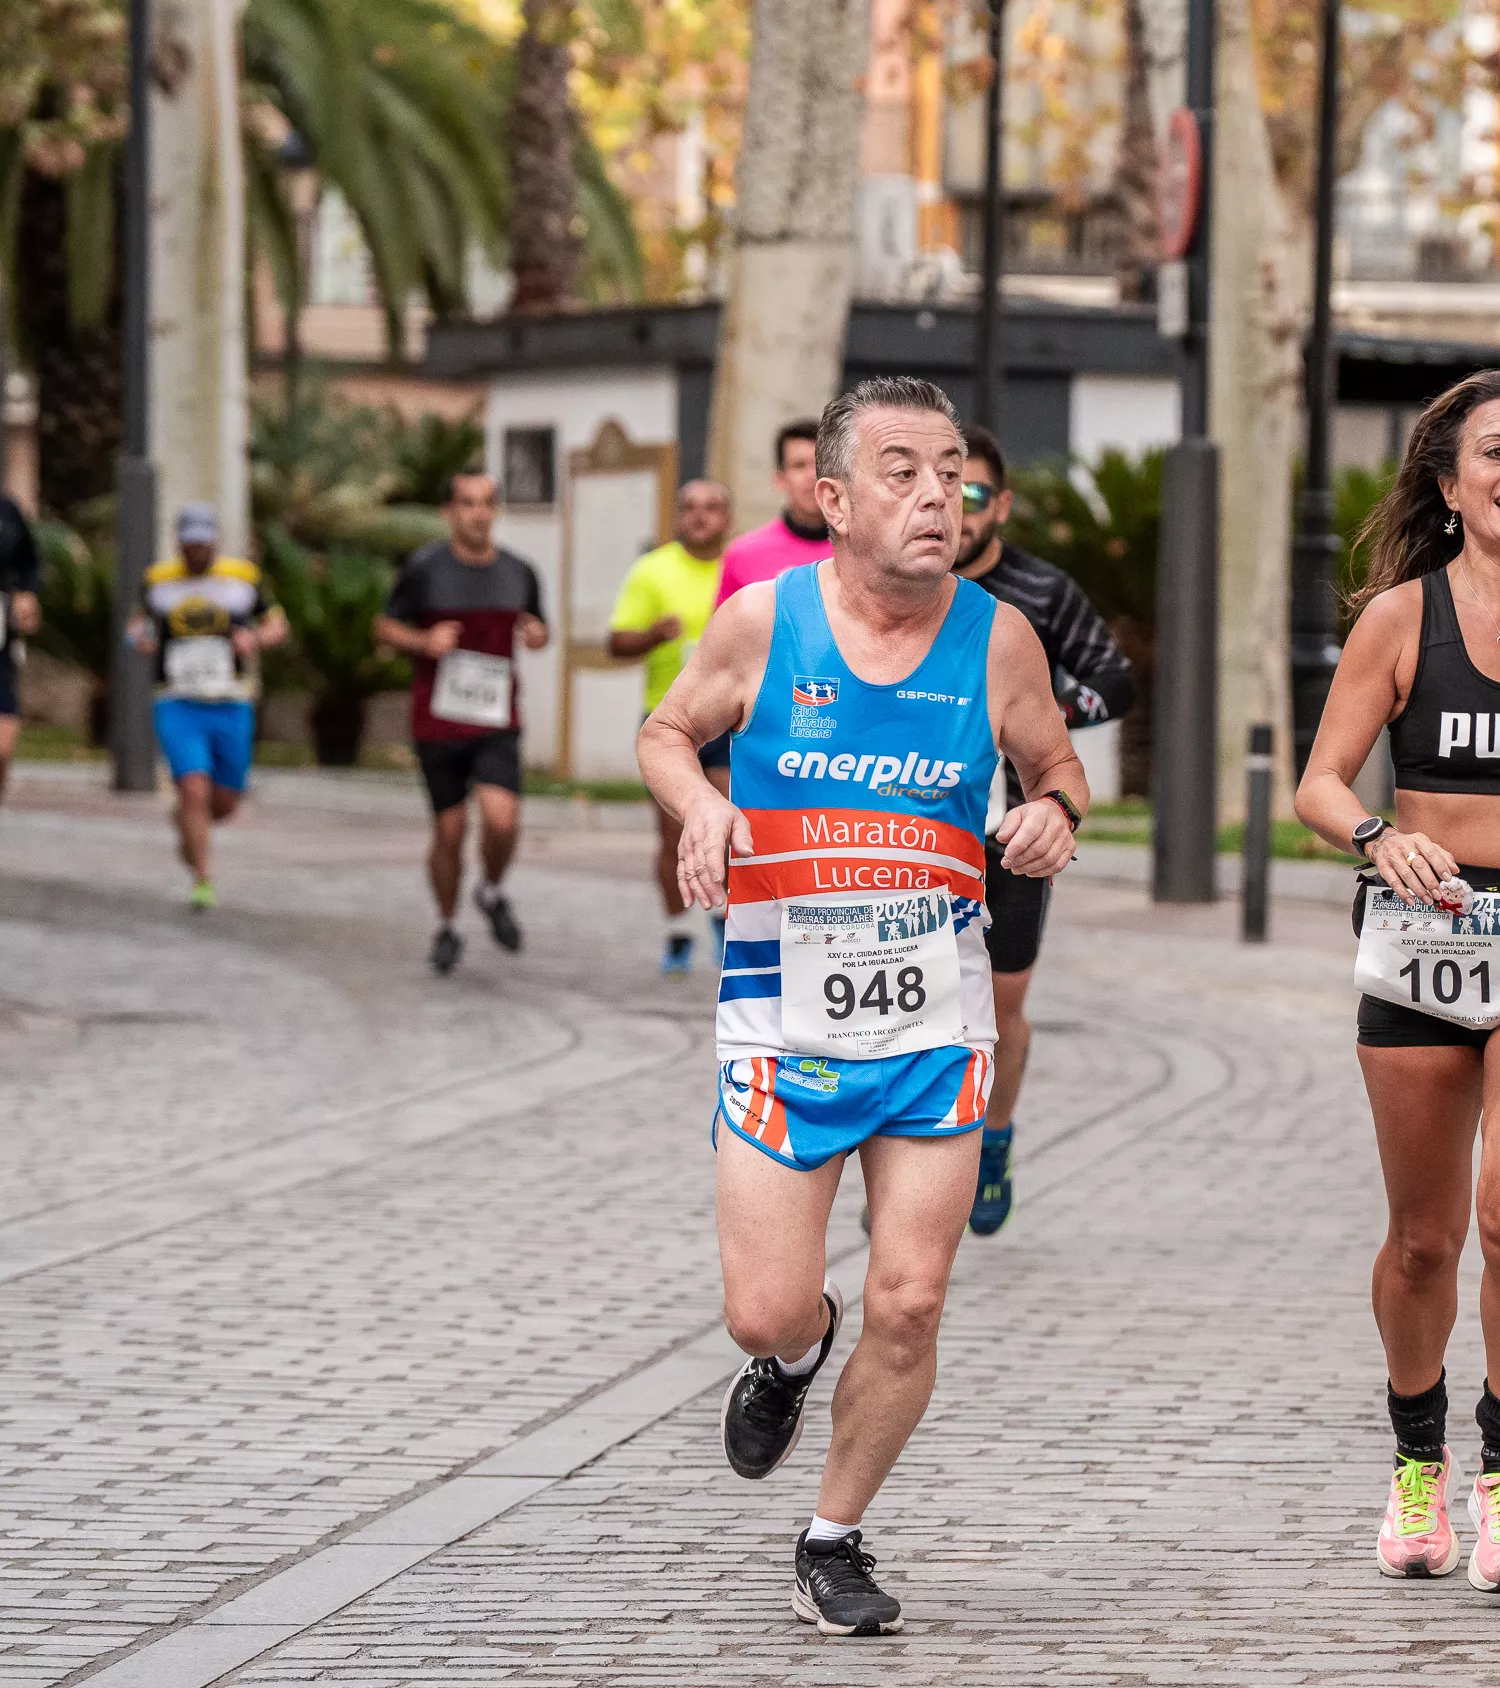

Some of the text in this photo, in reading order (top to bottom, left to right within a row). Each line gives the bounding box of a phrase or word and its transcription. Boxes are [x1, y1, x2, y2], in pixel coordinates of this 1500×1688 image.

[896, 690, 955, 704] GSPORT
[792, 705, 818, 717] Club
[791, 715, 837, 728] Maratón
[790, 725, 832, 738] Lucena
[877, 783, 950, 799] directo
[801, 813, 937, 851] Maratón
[813, 860, 930, 889] Lucena
[788, 906, 873, 916] CIRCUITO PROVINCIAL DE
[877, 899, 921, 920] 2024
[1371, 902, 1404, 911] CARRERAS
[788, 914, 874, 924] CARRERAS POPULARES
[842, 951, 855, 959] C.P.
[857, 949, 882, 958] CIUDAD
[894, 944, 919, 954] LUCENA
[868, 957, 905, 966] IGUALDAD
[1400, 958, 1491, 1004] 101
[823, 966, 926, 1020] 948
[827, 1020, 924, 1039] FRANCISCO ARCOS CORTES
